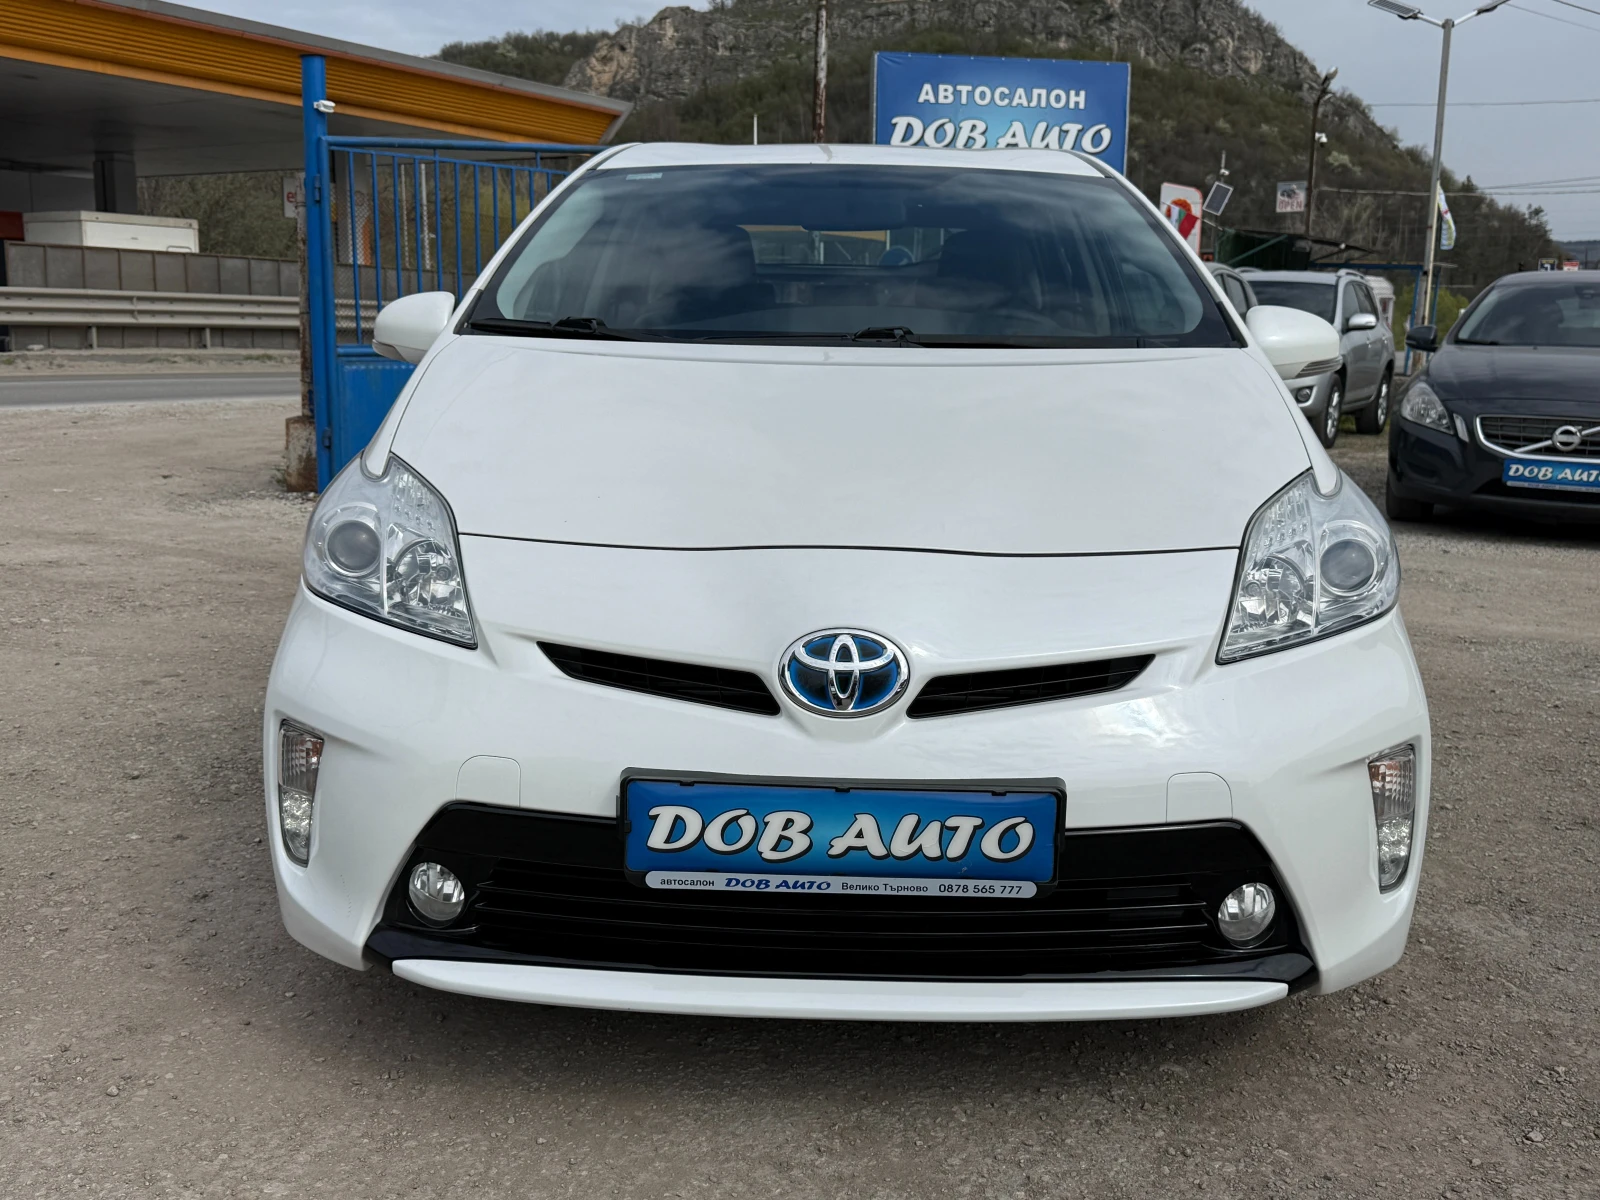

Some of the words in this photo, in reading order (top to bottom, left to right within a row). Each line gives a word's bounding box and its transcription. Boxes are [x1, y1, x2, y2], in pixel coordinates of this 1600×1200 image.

[917, 83, 1086, 110] АВТОСАЛОН
[890, 115, 988, 149] DOB
[997, 120, 1112, 153] AUTO
[1278, 199, 1303, 211] OPEN
[1508, 464, 1554, 481] DOB
[1557, 468, 1600, 482] AUT
[646, 805, 813, 863] DOB
[826, 813, 1036, 863] AUTO
[660, 877, 715, 887] автосалон
[724, 877, 771, 890] DOB
[774, 879, 832, 891] AUTO
[841, 882, 880, 892] Велико
[882, 883, 929, 894] Търново
[938, 883, 969, 894] 0878
[972, 885, 996, 895] 565
[999, 885, 1023, 895] 777
